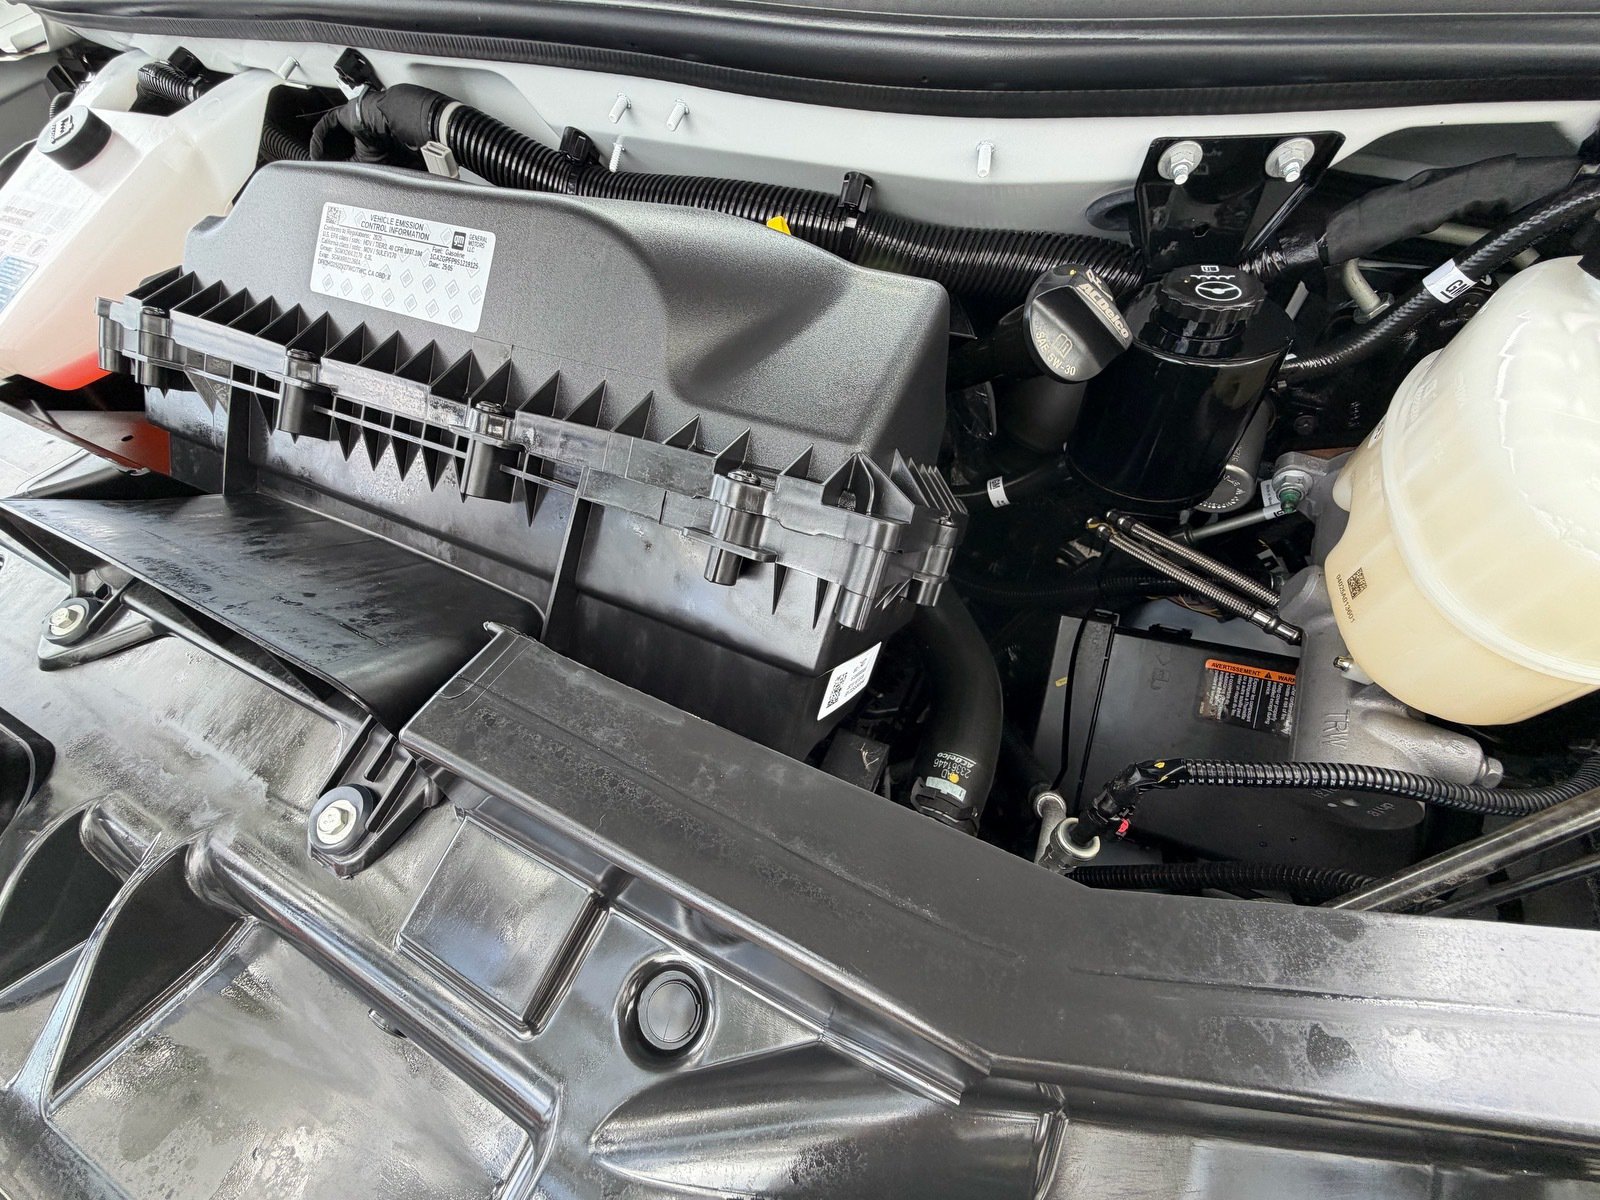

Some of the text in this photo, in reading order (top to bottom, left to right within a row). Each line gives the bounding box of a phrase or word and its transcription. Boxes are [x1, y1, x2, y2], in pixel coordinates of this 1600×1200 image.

[361, 221, 430, 241] CONTROL INFORMATION
[370, 215, 424, 231] VEHICLE EMISSION
[468, 240, 486, 249] MOTORS
[469, 234, 488, 243] GENERAL
[445, 249, 465, 259] Gasoline
[1076, 283, 1130, 340] ACDelco
[1036, 331, 1076, 376] SAE 5W-30
[1211, 663, 1261, 676] AVERTISSEMENT
[1322, 709, 1350, 749] TRW
[933, 758, 971, 779] 23361446
[937, 752, 976, 769] ACDelco
